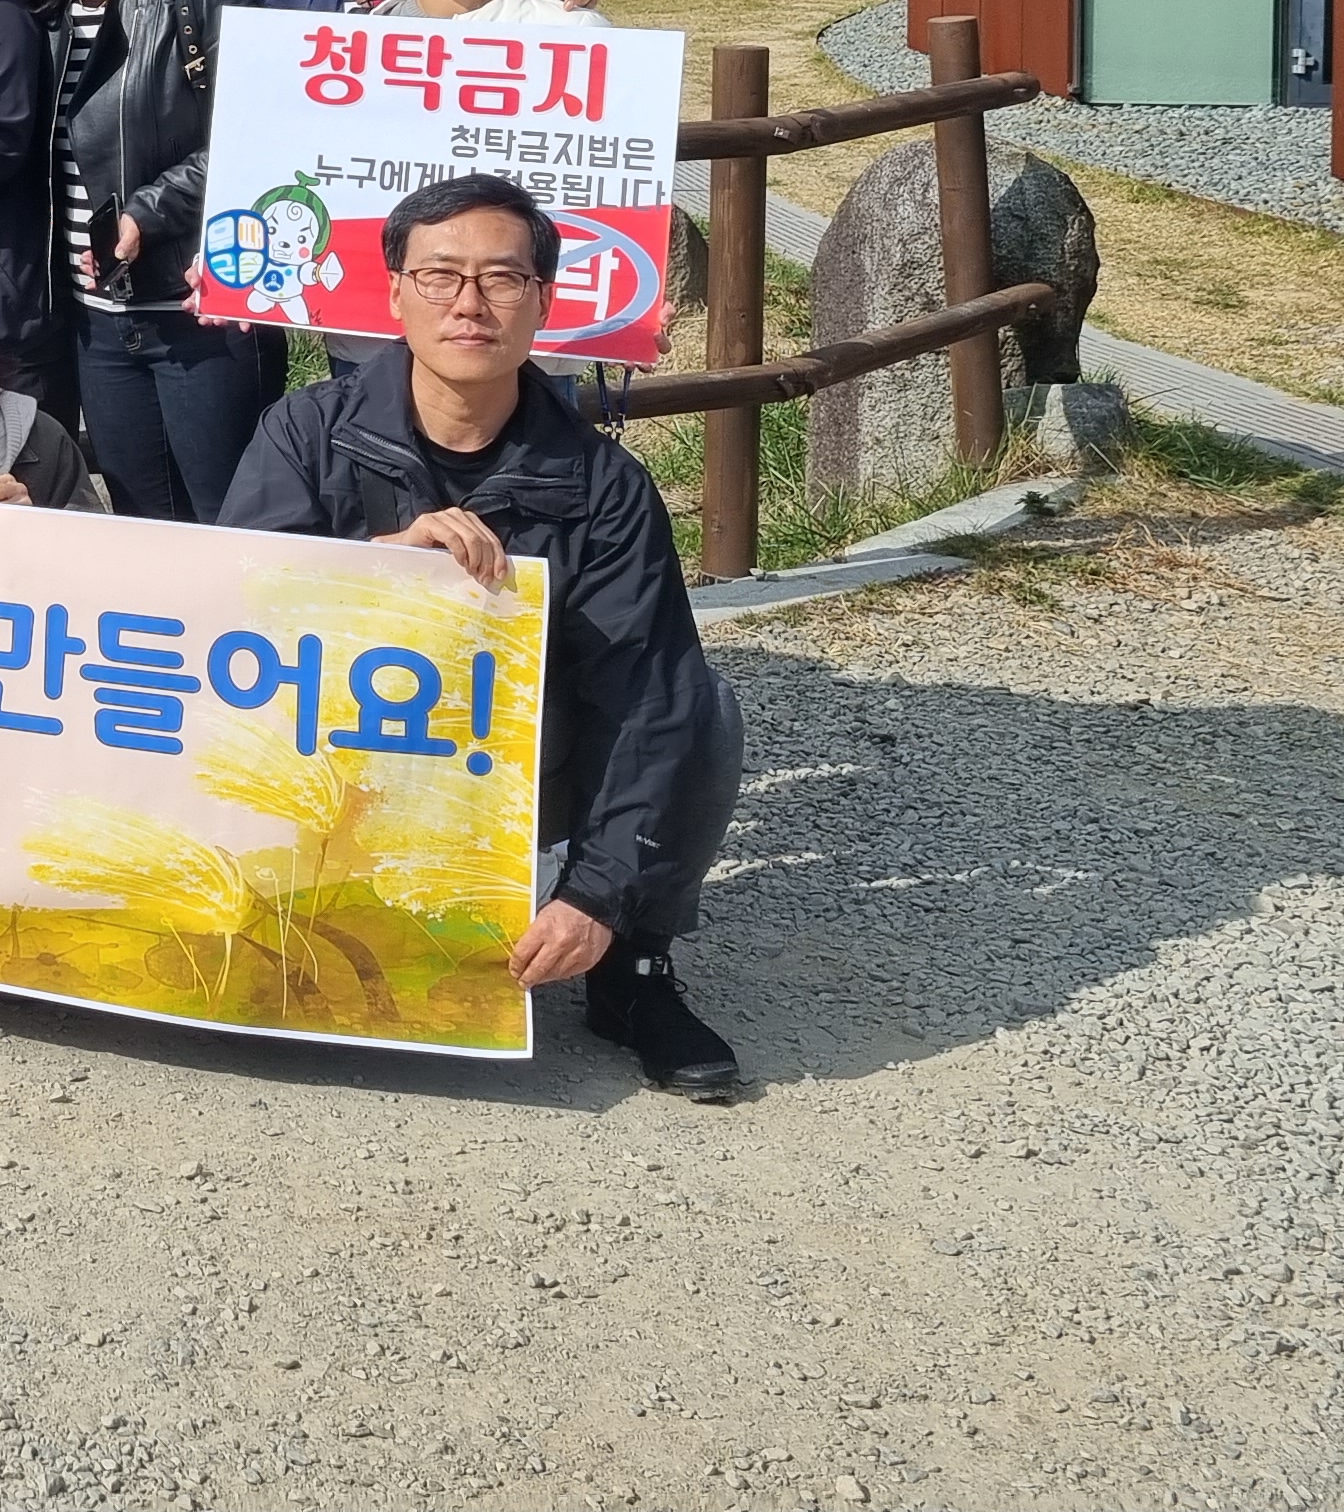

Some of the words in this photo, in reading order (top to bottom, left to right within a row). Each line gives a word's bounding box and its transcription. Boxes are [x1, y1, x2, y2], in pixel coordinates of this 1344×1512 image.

[299, 25, 609, 122] 청탁금지
[451, 125, 654, 171] 청탁금지법은
[313, 154, 476, 193] 누구에게
